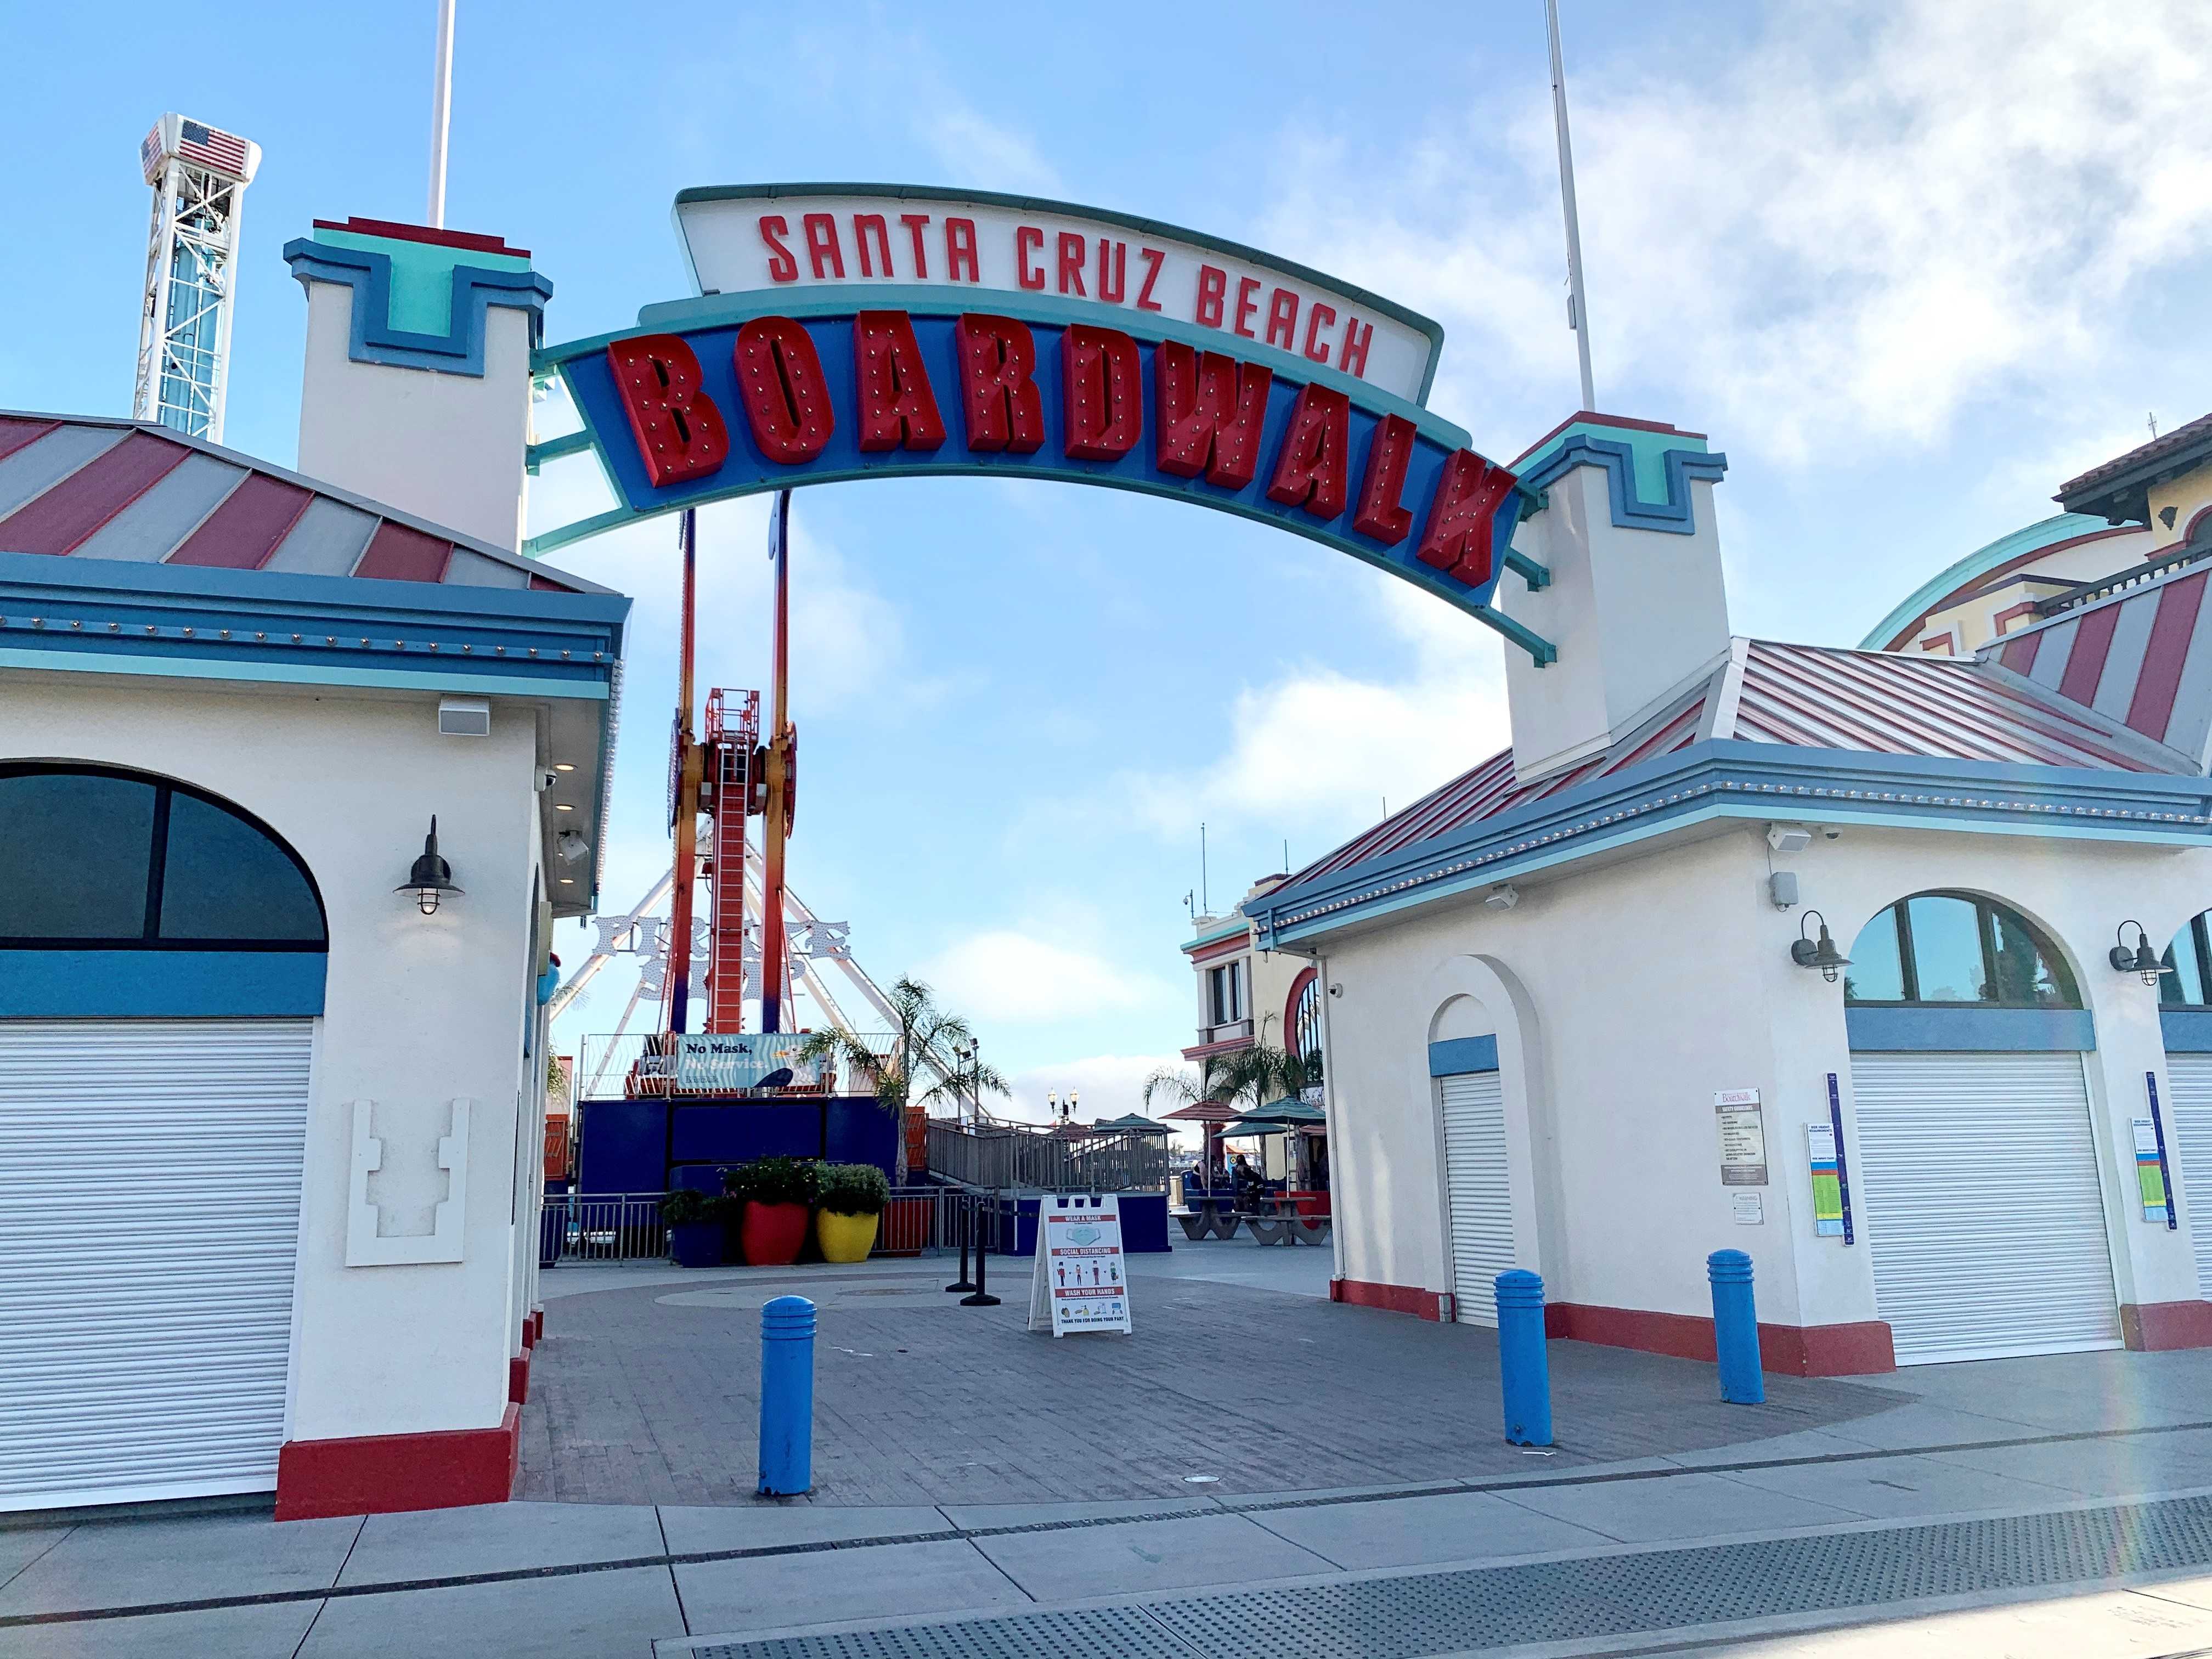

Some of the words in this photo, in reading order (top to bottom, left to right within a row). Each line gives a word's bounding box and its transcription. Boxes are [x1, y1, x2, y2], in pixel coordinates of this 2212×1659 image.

[759, 213, 980, 283] SANTA
[1017, 225, 1166, 312] CRUZ
[1196, 264, 1374, 379] BEACH
[607, 309, 1519, 589] BOARDWALK
[686, 1043, 706, 1054] No
[710, 1043, 752, 1056] Mask,
[686, 1059, 705, 1070] No
[710, 1058, 768, 1070] Service.
